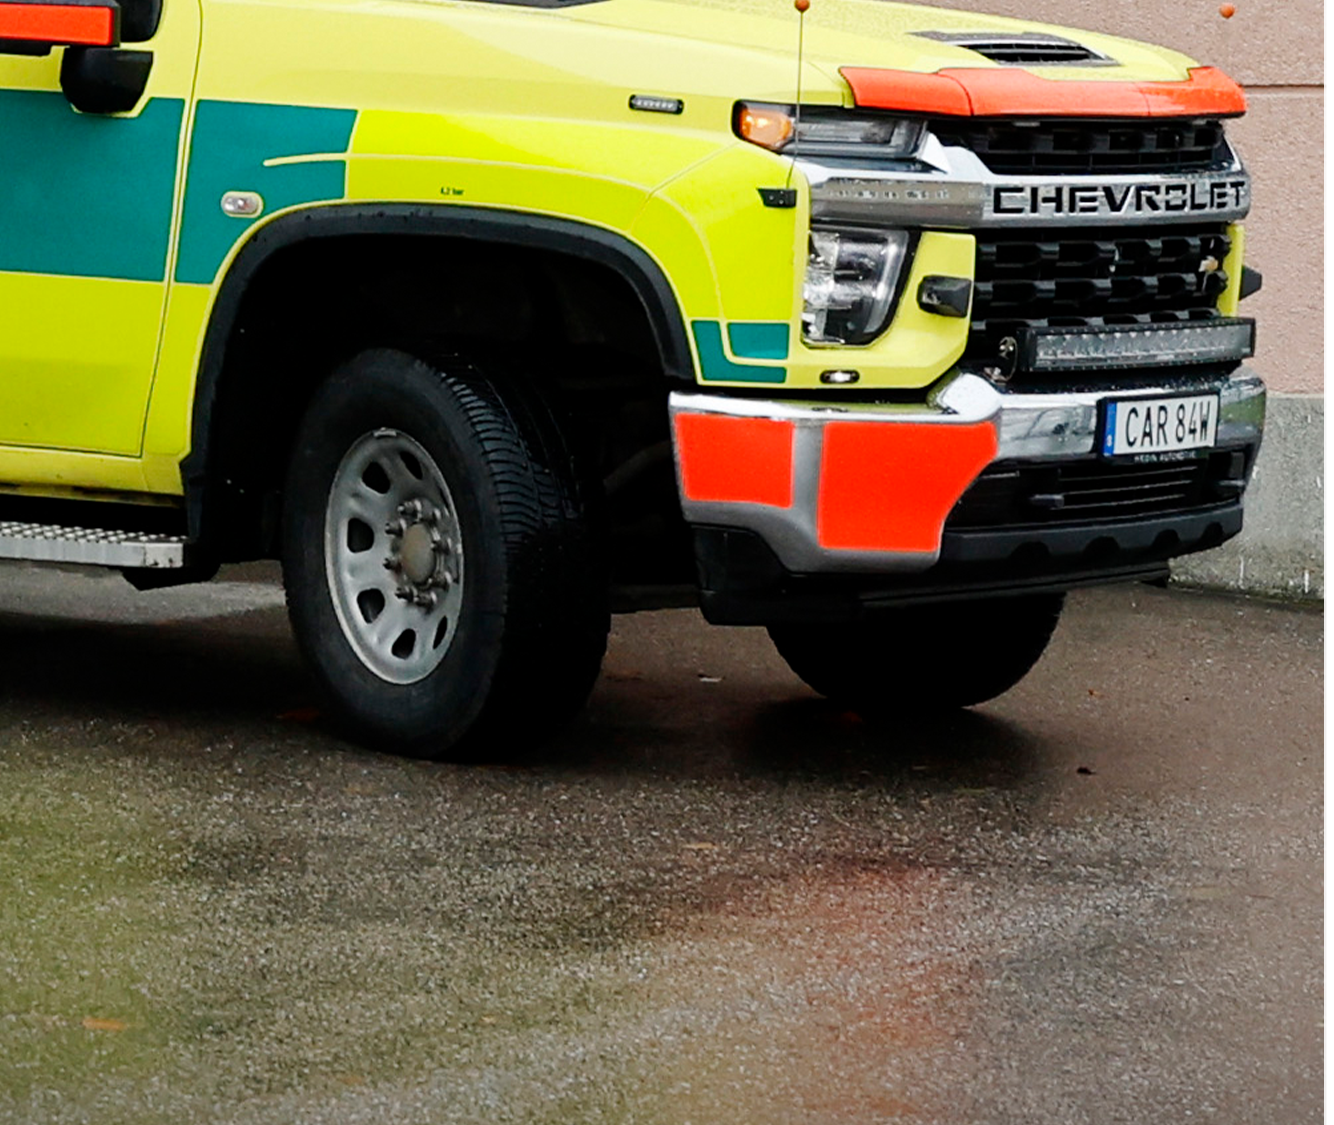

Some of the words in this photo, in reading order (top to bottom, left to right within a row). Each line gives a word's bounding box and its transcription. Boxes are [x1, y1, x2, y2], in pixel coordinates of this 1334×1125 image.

[993, 181, 1245, 214] CHEVROLET
[1126, 405, 1168, 447] CAR
[1176, 400, 1210, 443] 84W
